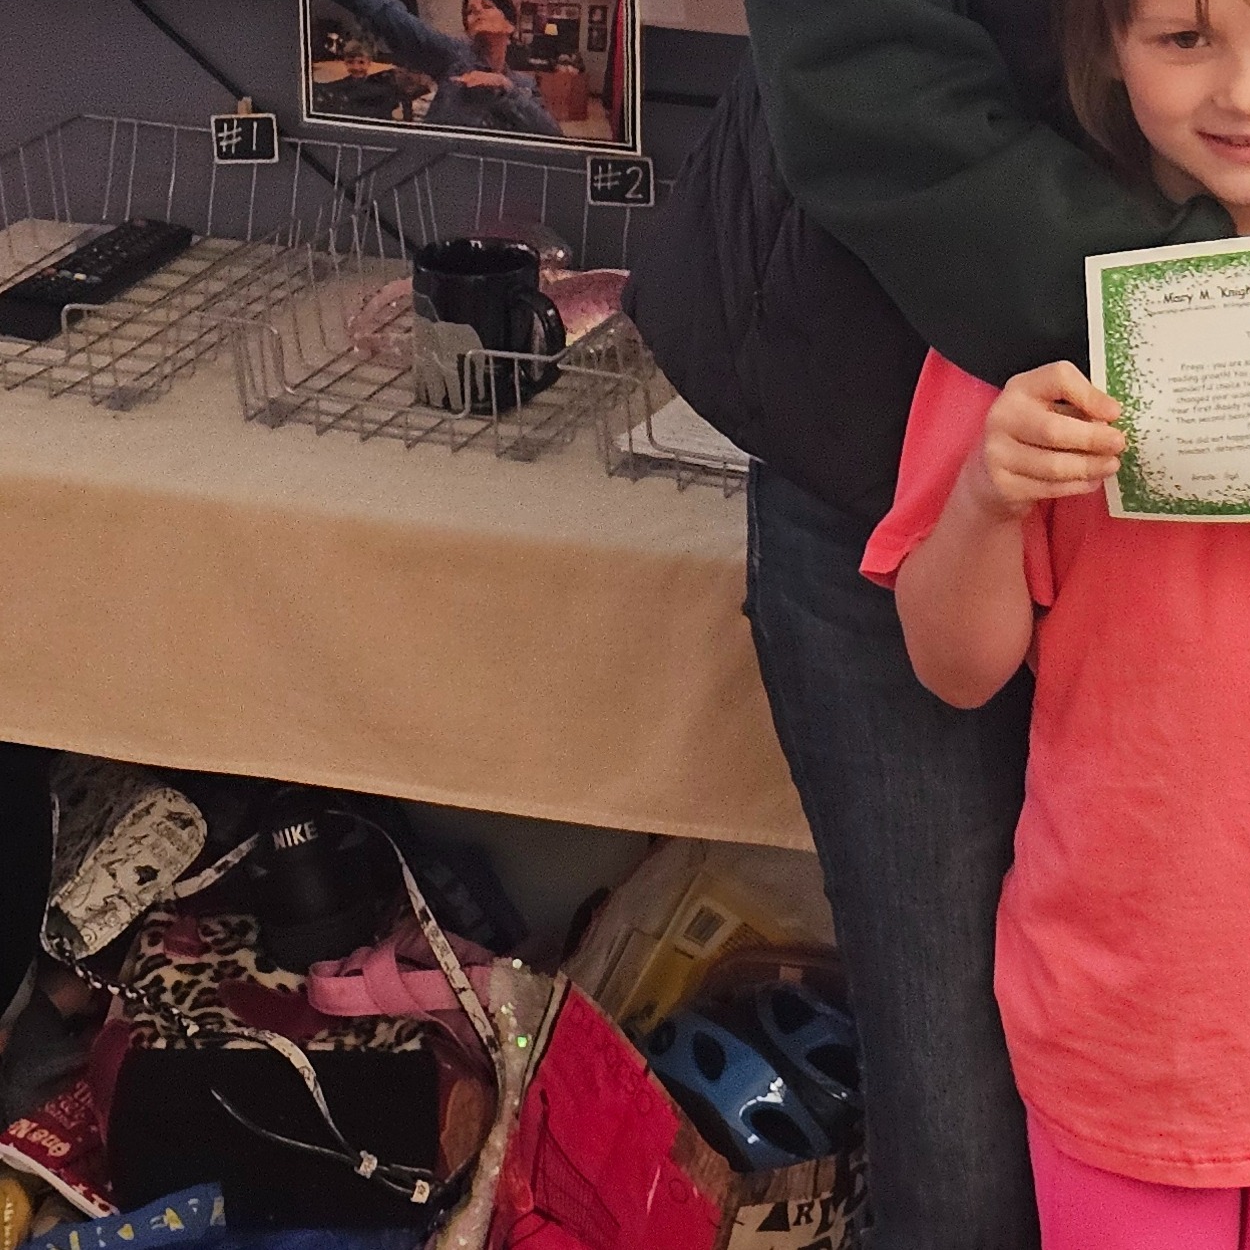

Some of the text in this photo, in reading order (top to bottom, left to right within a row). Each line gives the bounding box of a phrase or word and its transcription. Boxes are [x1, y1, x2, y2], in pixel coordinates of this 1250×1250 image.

[217, 120, 258, 155] #1
[593, 164, 643, 200] #2
[1163, 289, 1193, 304] Mary
[271, 821, 320, 851] NIKE
